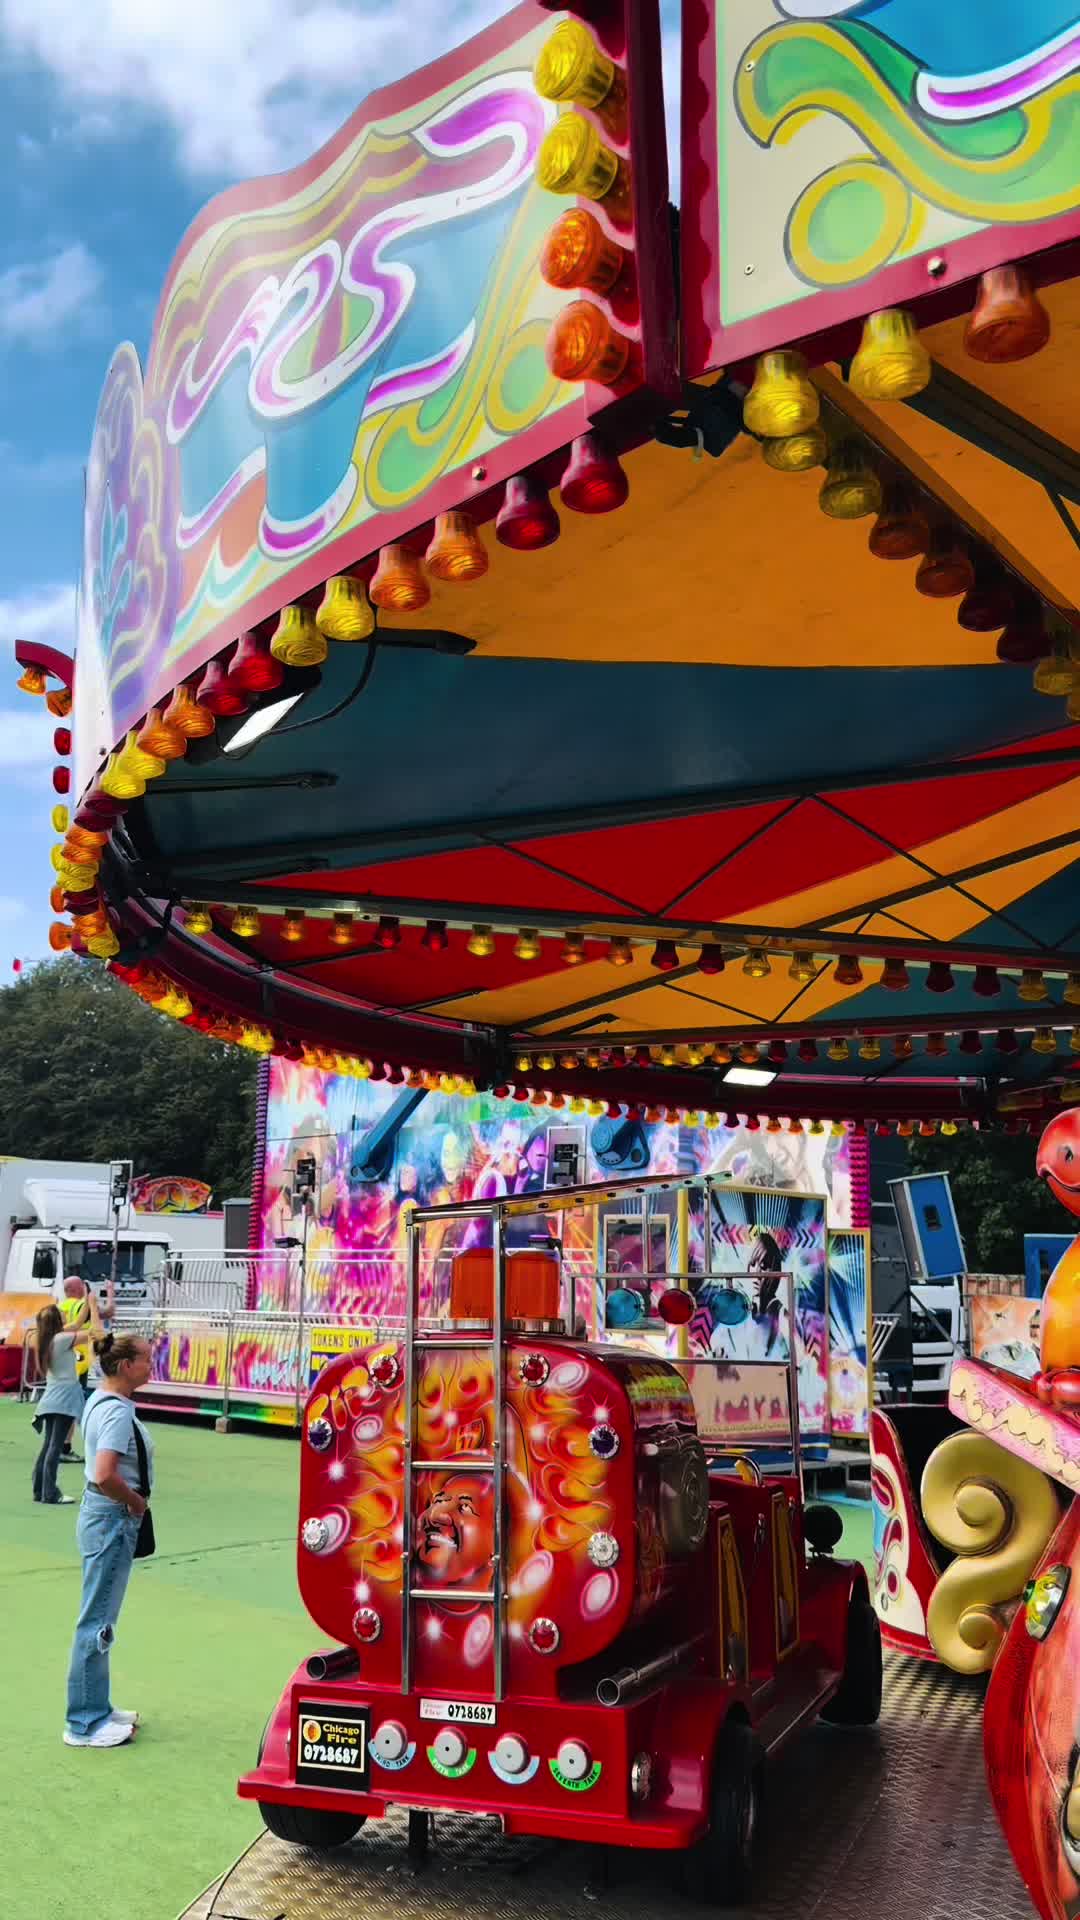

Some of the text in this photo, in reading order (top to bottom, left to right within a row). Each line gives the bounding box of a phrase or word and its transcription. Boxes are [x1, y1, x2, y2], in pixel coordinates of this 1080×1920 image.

[313, 1333, 371, 1348] TOKENS ONLY
[448, 1704, 493, 1720] 0728687
[322, 1723, 360, 1736] Chicago
[327, 1733, 357, 1745] Fire
[303, 1744, 359, 1765] 0728687
